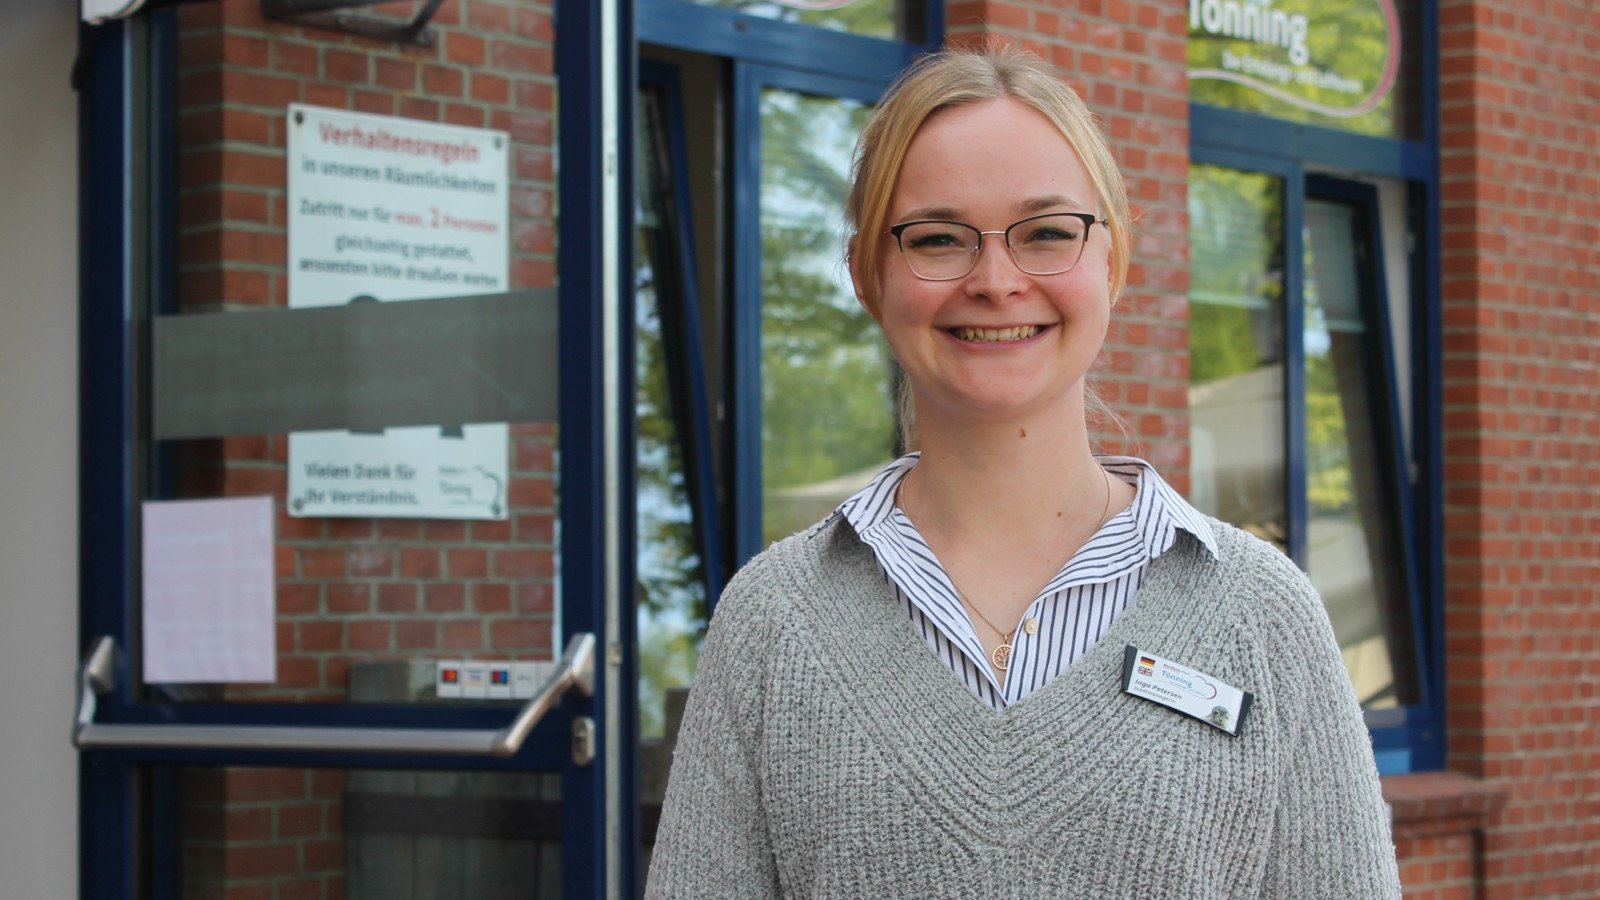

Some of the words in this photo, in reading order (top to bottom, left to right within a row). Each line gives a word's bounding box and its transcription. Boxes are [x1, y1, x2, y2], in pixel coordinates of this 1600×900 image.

[320, 123, 479, 163] Verhaltensregeln
[303, 157, 316, 173] in
[321, 162, 379, 180] unseren
[385, 167, 495, 193] Räumlichkeiten
[301, 200, 343, 216] Zutritt
[350, 208, 368, 220] nur
[373, 207, 390, 223] für
[430, 207, 441, 228] 2
[444, 216, 497, 232] Personen
[336, 235, 409, 257] gleichzeitig
[414, 243, 473, 261] gestattet,
[300, 259, 368, 274] ansonsten
[372, 263, 400, 277] bitte
[407, 265, 458, 282] draußen
[304, 463, 350, 480] Vielen
[353, 463, 392, 480] Dank
[395, 463, 416, 480] für
[304, 489, 326, 503] Ihr
[329, 487, 420, 506] Verständnis.
[1134, 679, 1151, 690] Inga
[1151, 681, 1183, 700] Petersen
